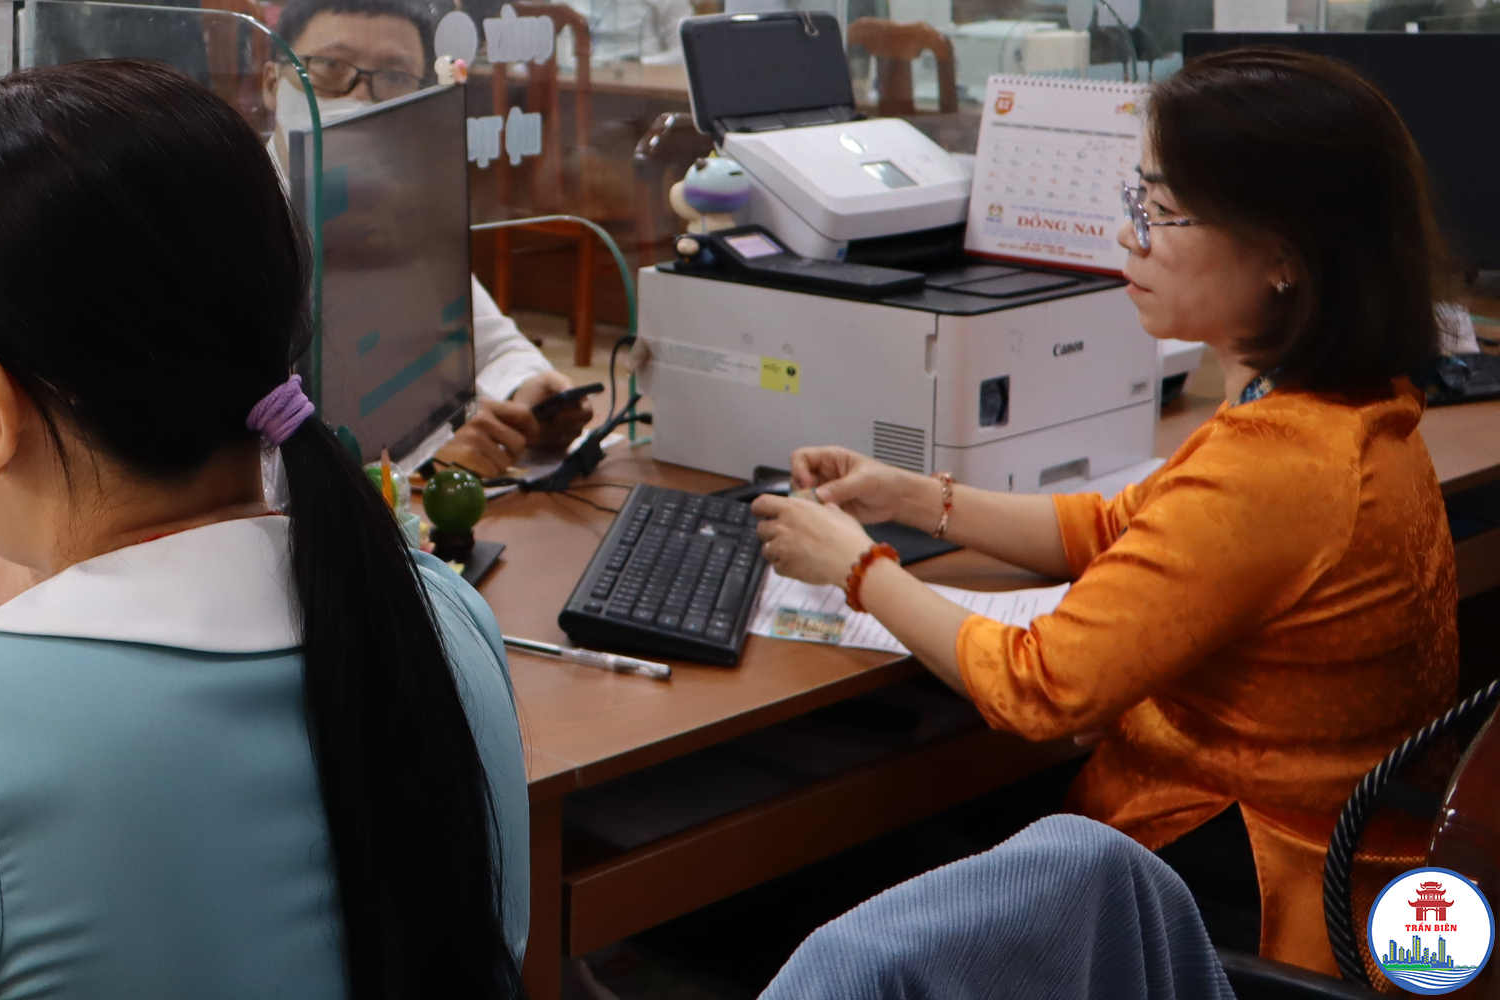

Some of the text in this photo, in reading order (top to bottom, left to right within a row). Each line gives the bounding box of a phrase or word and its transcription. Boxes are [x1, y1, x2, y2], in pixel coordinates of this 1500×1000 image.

[1017, 213, 1067, 232] ĐỒNG
[1073, 221, 1105, 236] NAI
[1053, 340, 1084, 357] Canon
